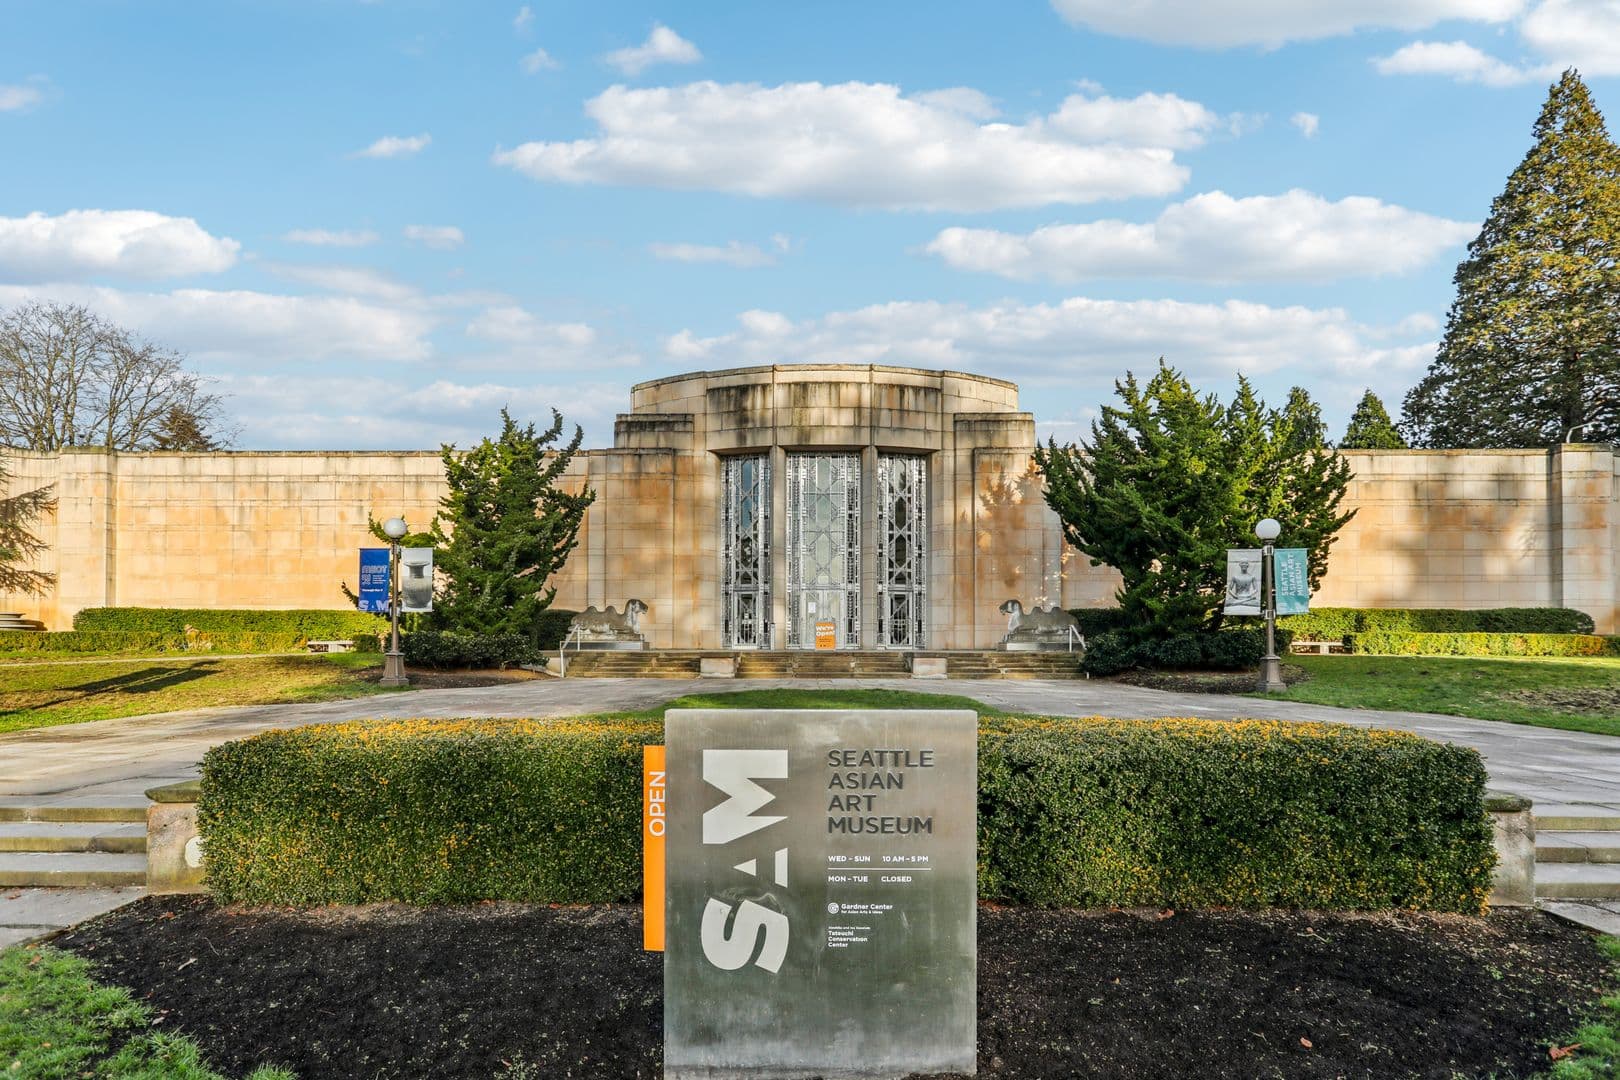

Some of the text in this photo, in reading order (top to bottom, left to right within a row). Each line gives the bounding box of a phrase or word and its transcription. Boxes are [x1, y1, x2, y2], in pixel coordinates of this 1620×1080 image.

[1281, 561, 1290, 596] SEATTLE
[1287, 552, 1297, 596] ASIAN ART
[1295, 562, 1304, 596] MUSEUM
[358, 600, 390, 612] SAM
[828, 750, 935, 768] SEATTLE
[828, 772, 904, 790] ASIAN
[648, 770, 666, 837] OPEN
[828, 794, 877, 812] ART
[828, 816, 933, 834] MUSEUM
[701, 750, 789, 973] SAM
